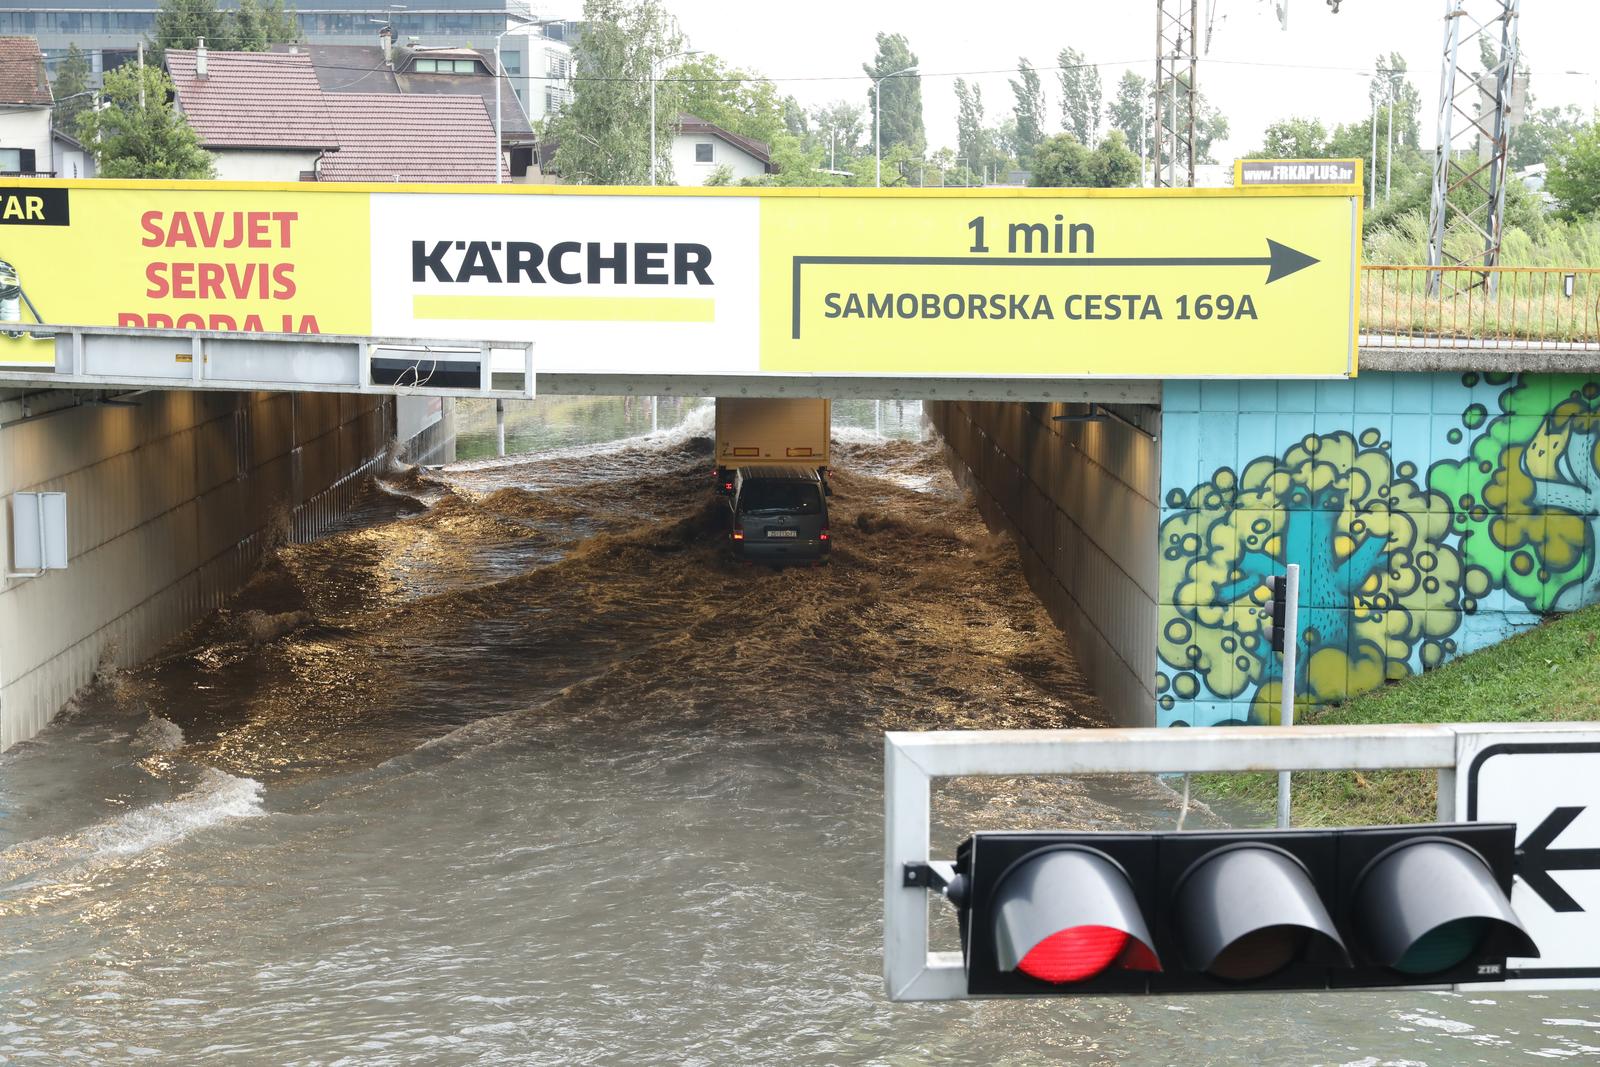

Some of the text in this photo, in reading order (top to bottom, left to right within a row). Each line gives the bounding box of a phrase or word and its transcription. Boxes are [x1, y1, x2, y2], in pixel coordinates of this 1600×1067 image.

[0, 195, 46, 220] AR
[140, 210, 299, 249] SAVJET
[968, 214, 1095, 254] 1 min
[145, 261, 297, 301] SERVIS
[412, 240, 715, 286] KÄRCHER
[824, 292, 1259, 321] SAMOBORSKA CESTA 169A
